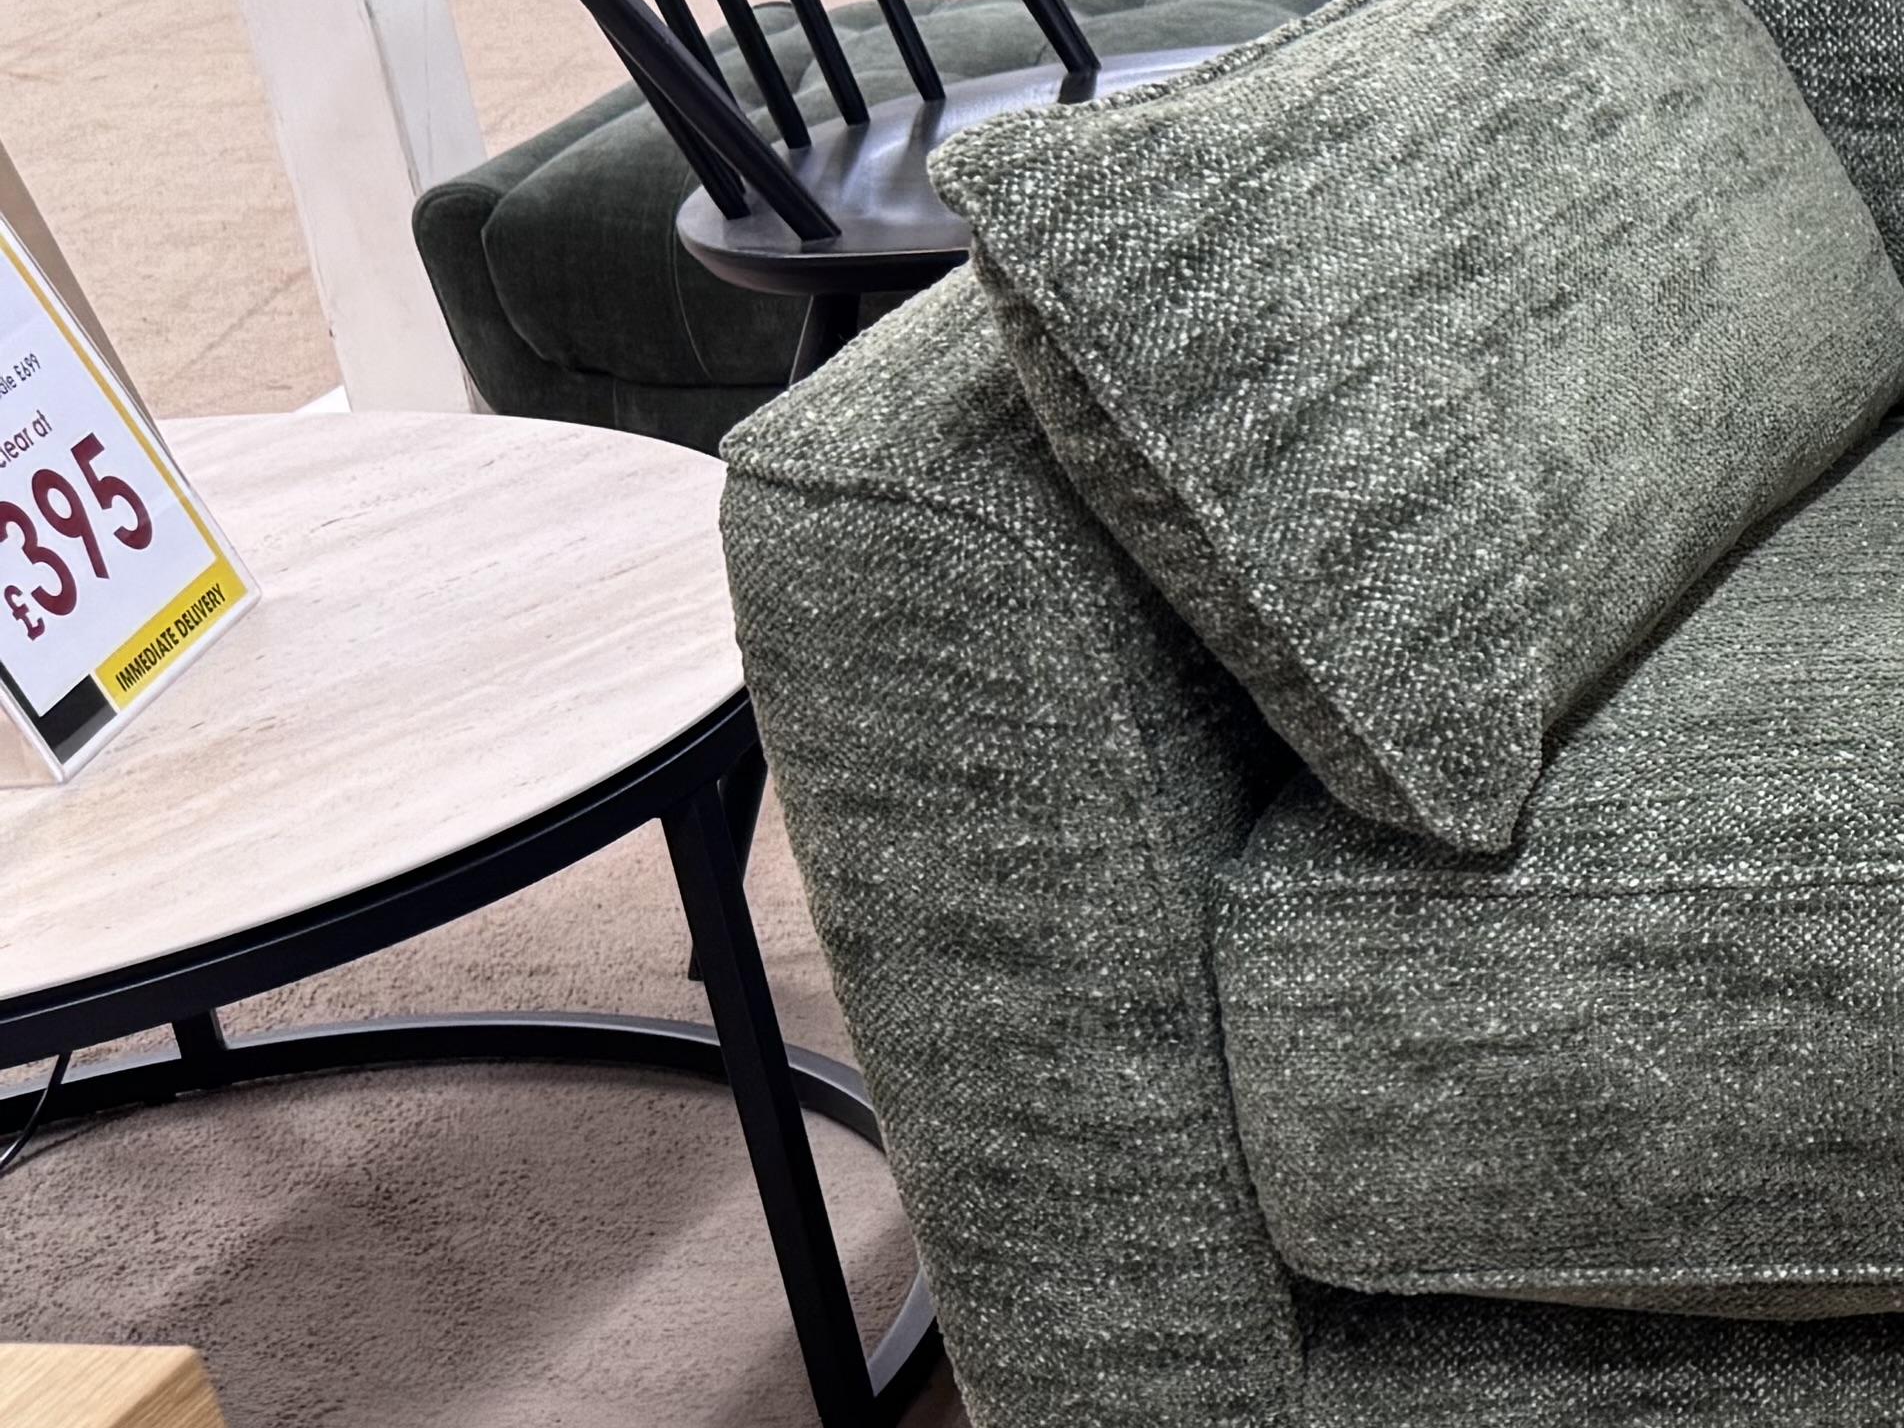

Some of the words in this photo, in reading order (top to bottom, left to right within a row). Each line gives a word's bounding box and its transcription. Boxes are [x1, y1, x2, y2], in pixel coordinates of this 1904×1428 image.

[32, 409, 53, 438] at
[0, 432, 153, 641] £395
[115, 627, 179, 692] IMMEDIATE
[174, 583, 226, 641] DELIVERY
